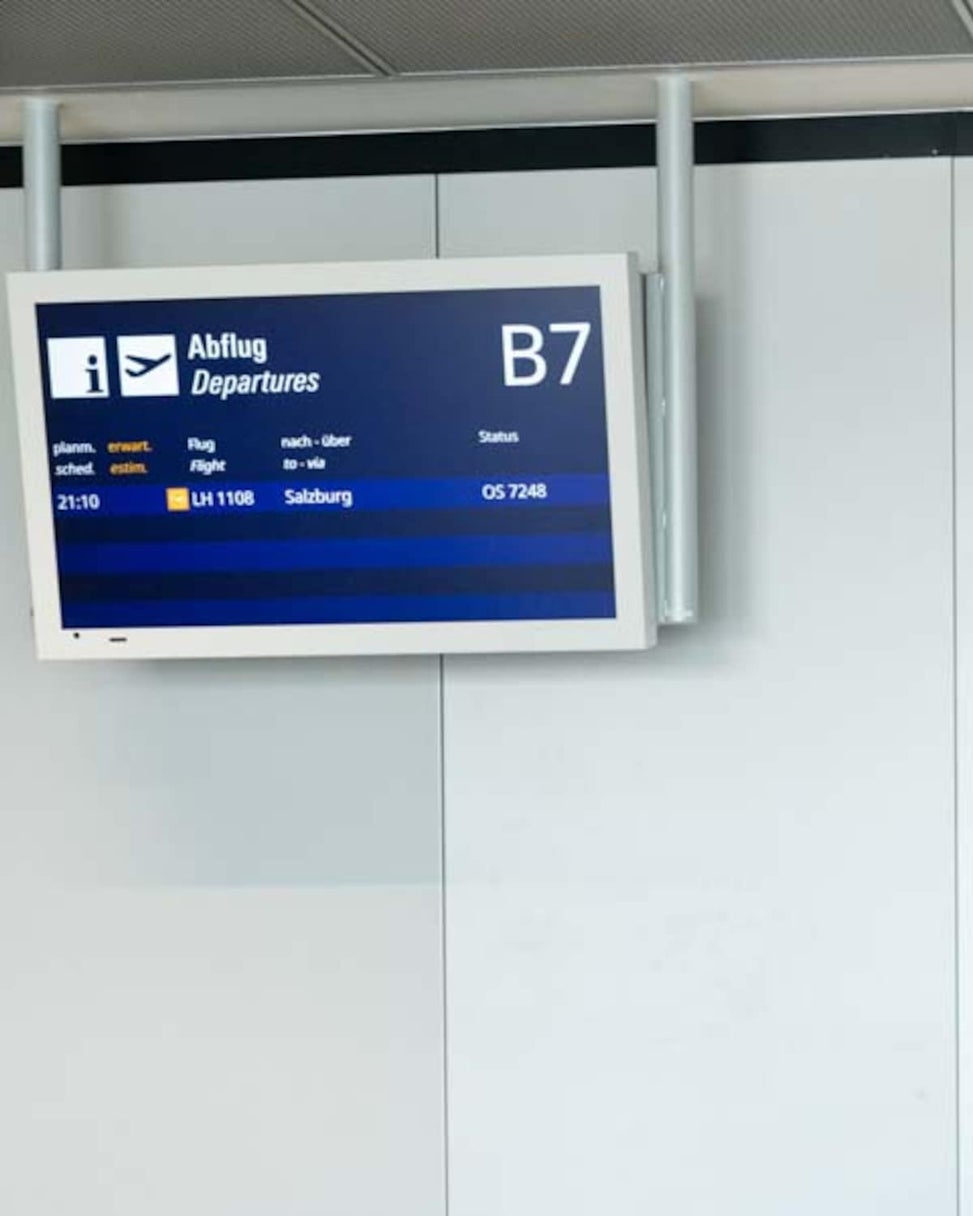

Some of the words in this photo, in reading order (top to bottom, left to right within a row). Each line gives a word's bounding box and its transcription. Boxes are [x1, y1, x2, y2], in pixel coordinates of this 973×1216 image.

[187, 332, 267, 364] Abflug
[501, 321, 592, 387] B7
[85, 354, 104, 393] i
[190, 368, 321, 400] Departures
[187, 436, 217, 453] Flug
[280, 434, 313, 449] nach
[321, 433, 352, 448] über
[477, 429, 520, 444] Status
[52, 441, 97, 457] planm.
[107, 440, 153, 453] erwart.
[54, 461, 96, 476] sched.
[109, 460, 148, 475] estim.
[189, 459, 227, 475] Flight
[282, 458, 298, 470] to
[306, 456, 326, 470] via
[191, 491, 214, 507] LH
[217, 489, 256, 507] 1108
[284, 488, 353, 509] Salzburg
[481, 483, 506, 500] OS
[507, 481, 548, 499] 7248
[57, 493, 101, 511] 21:10
